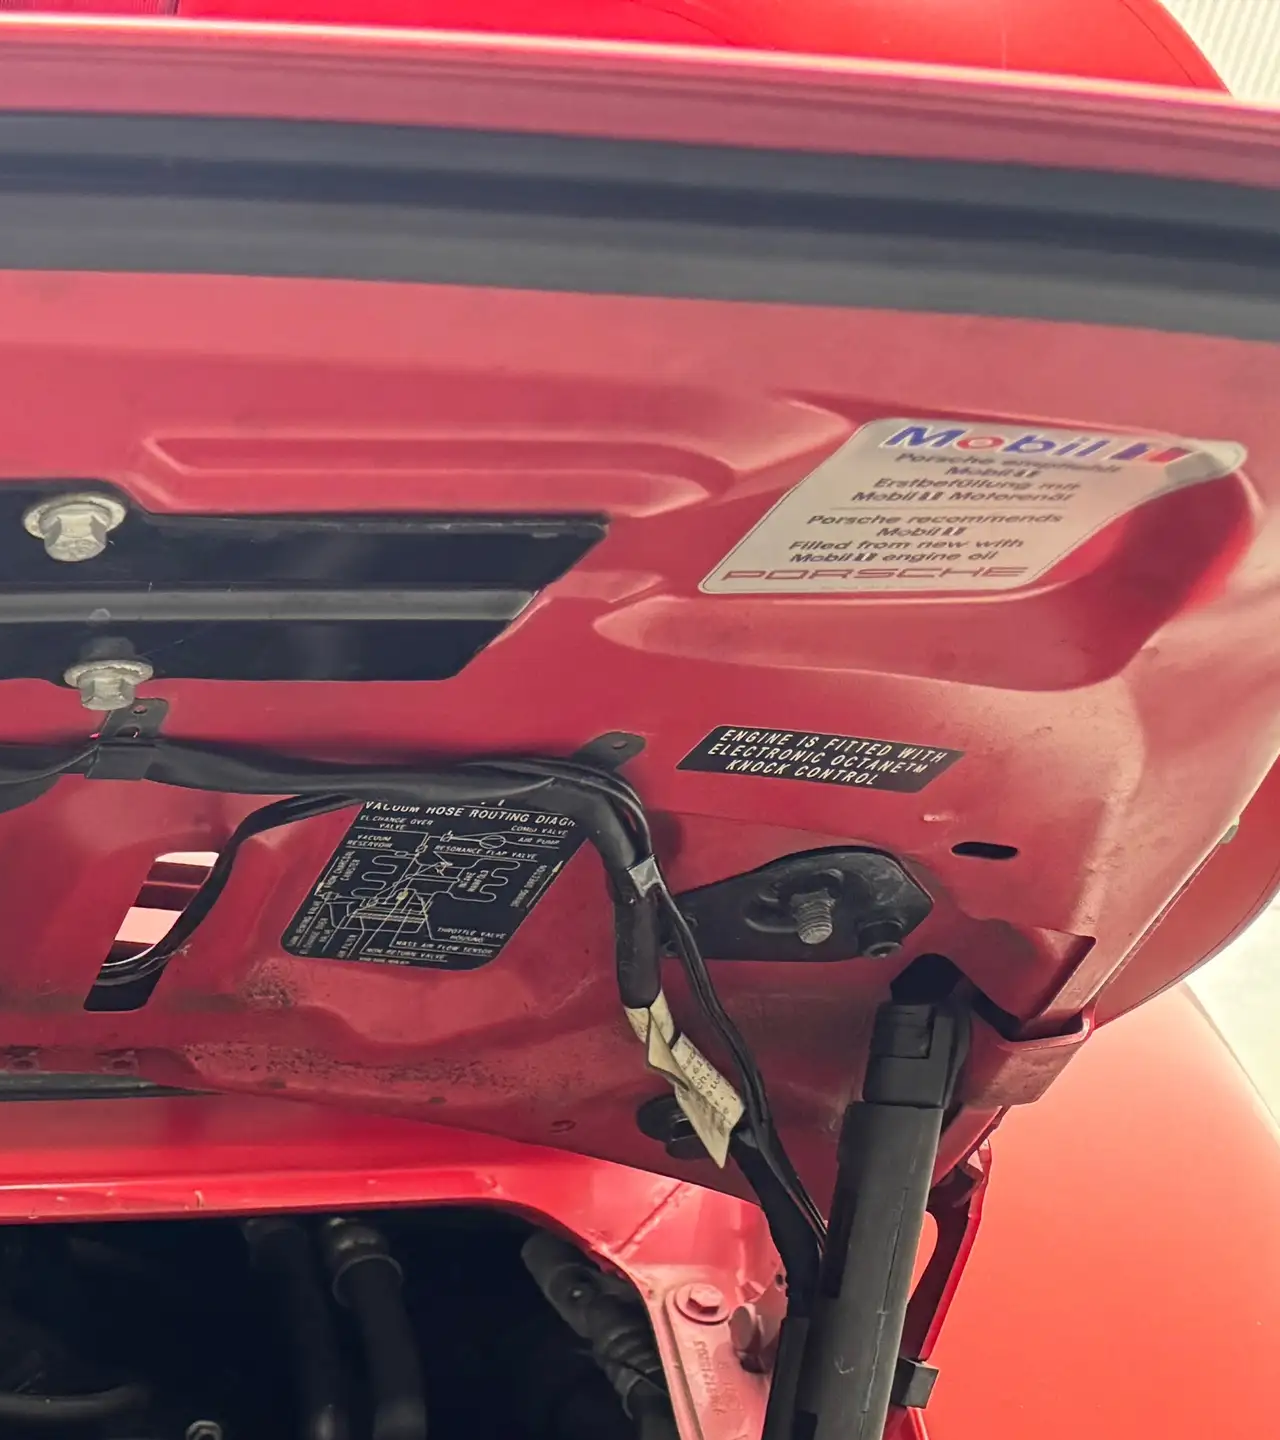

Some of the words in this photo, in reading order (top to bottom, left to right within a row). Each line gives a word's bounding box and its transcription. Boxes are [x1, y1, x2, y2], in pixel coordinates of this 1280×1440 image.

[885, 426, 1109, 458] Mobil
[895, 453, 995, 465] Porsche
[806, 514, 902, 525] Porsche
[907, 513, 1064, 524] recommends
[788, 540, 846, 550] Filled
[851, 540, 910, 551] from
[916, 540, 969, 549] new
[975, 538, 1024, 548] with
[881, 552, 963, 563] engine
[968, 551, 997, 561] oil
[720, 566, 1029, 582] PORSCHE
[707, 743, 827, 764] ELECTRONIC
[719, 729, 793, 746] ENGINE
[796, 735, 819, 749] IS
[825, 738, 893, 756] FITTED
[899, 747, 948, 764] WITH
[725, 759, 791, 776] KNOCK
[794, 765, 880, 785] CONTROL
[426, 805, 464, 817] HOSE
[469, 809, 529, 823] ROUTING
[410, 818, 434, 826] OVER
[541, 829, 569, 837] VALVE
